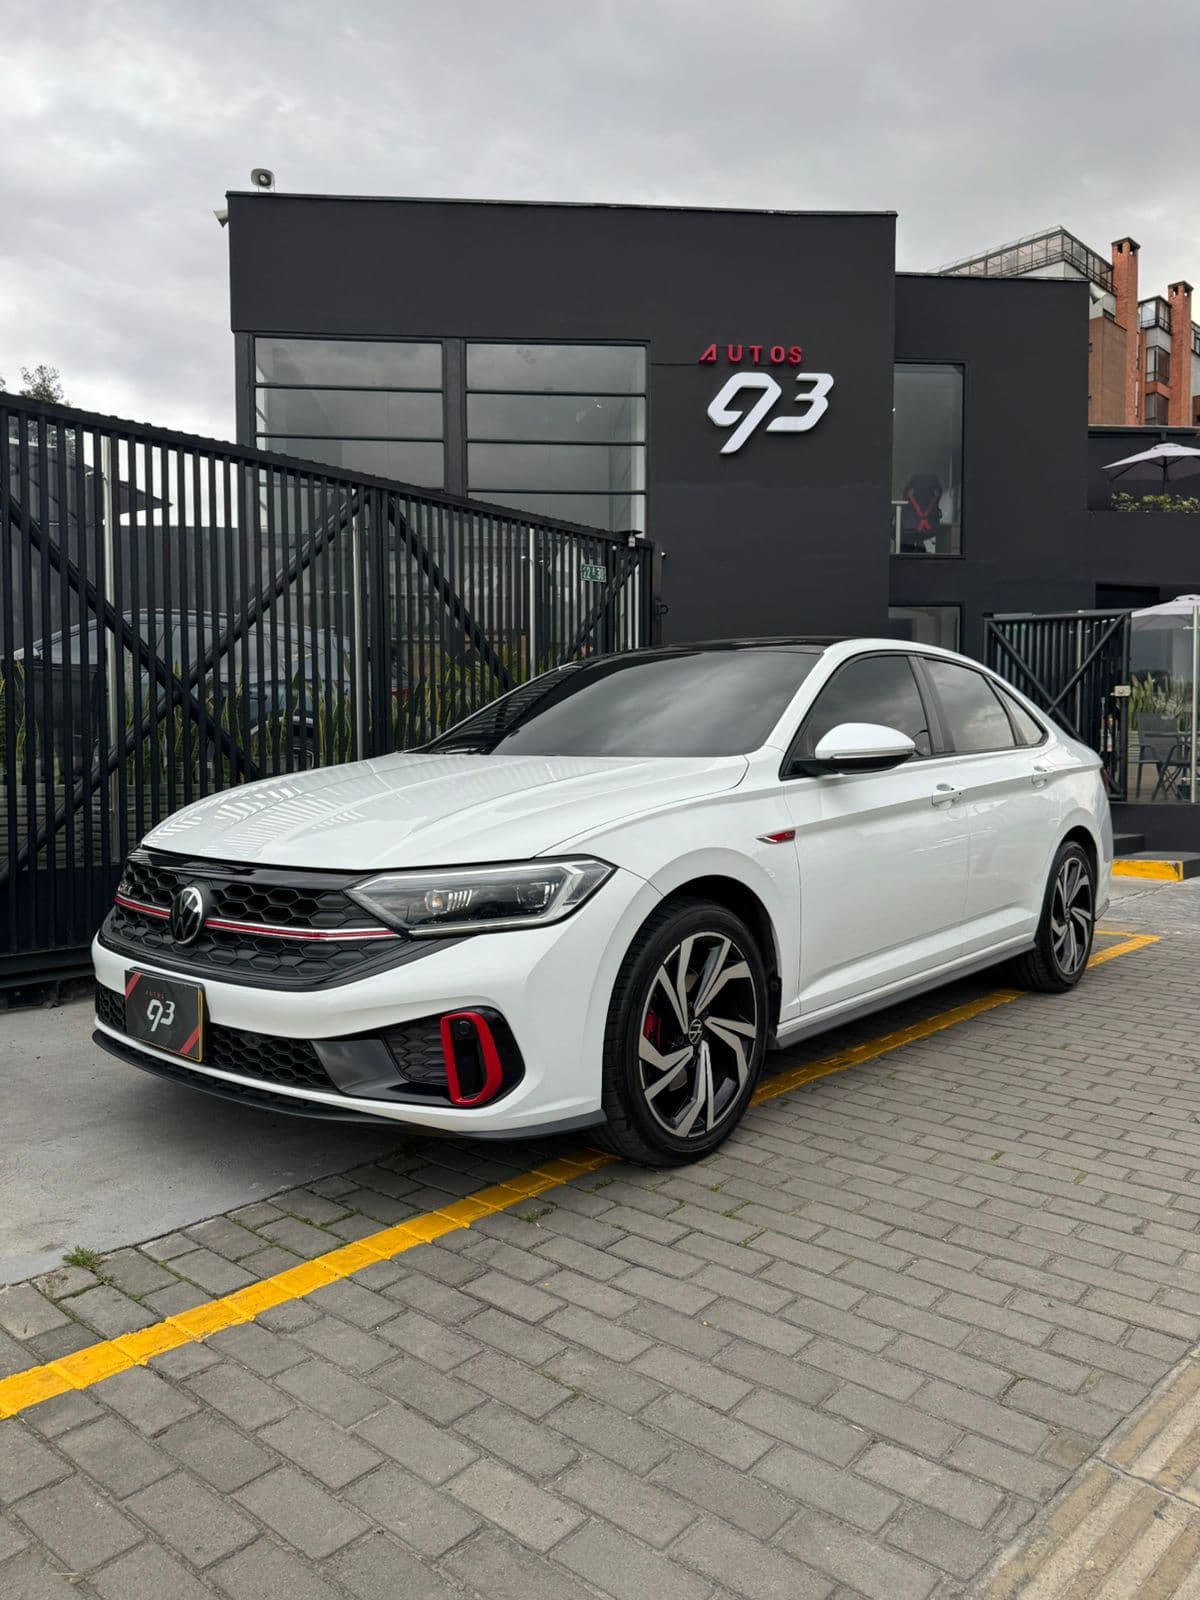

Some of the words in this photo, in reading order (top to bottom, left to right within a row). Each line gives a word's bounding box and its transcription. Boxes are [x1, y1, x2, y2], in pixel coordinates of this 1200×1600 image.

[699, 343, 803, 364] AUTOS
[707, 371, 835, 454] 93
[146, 998, 176, 1032] 93
